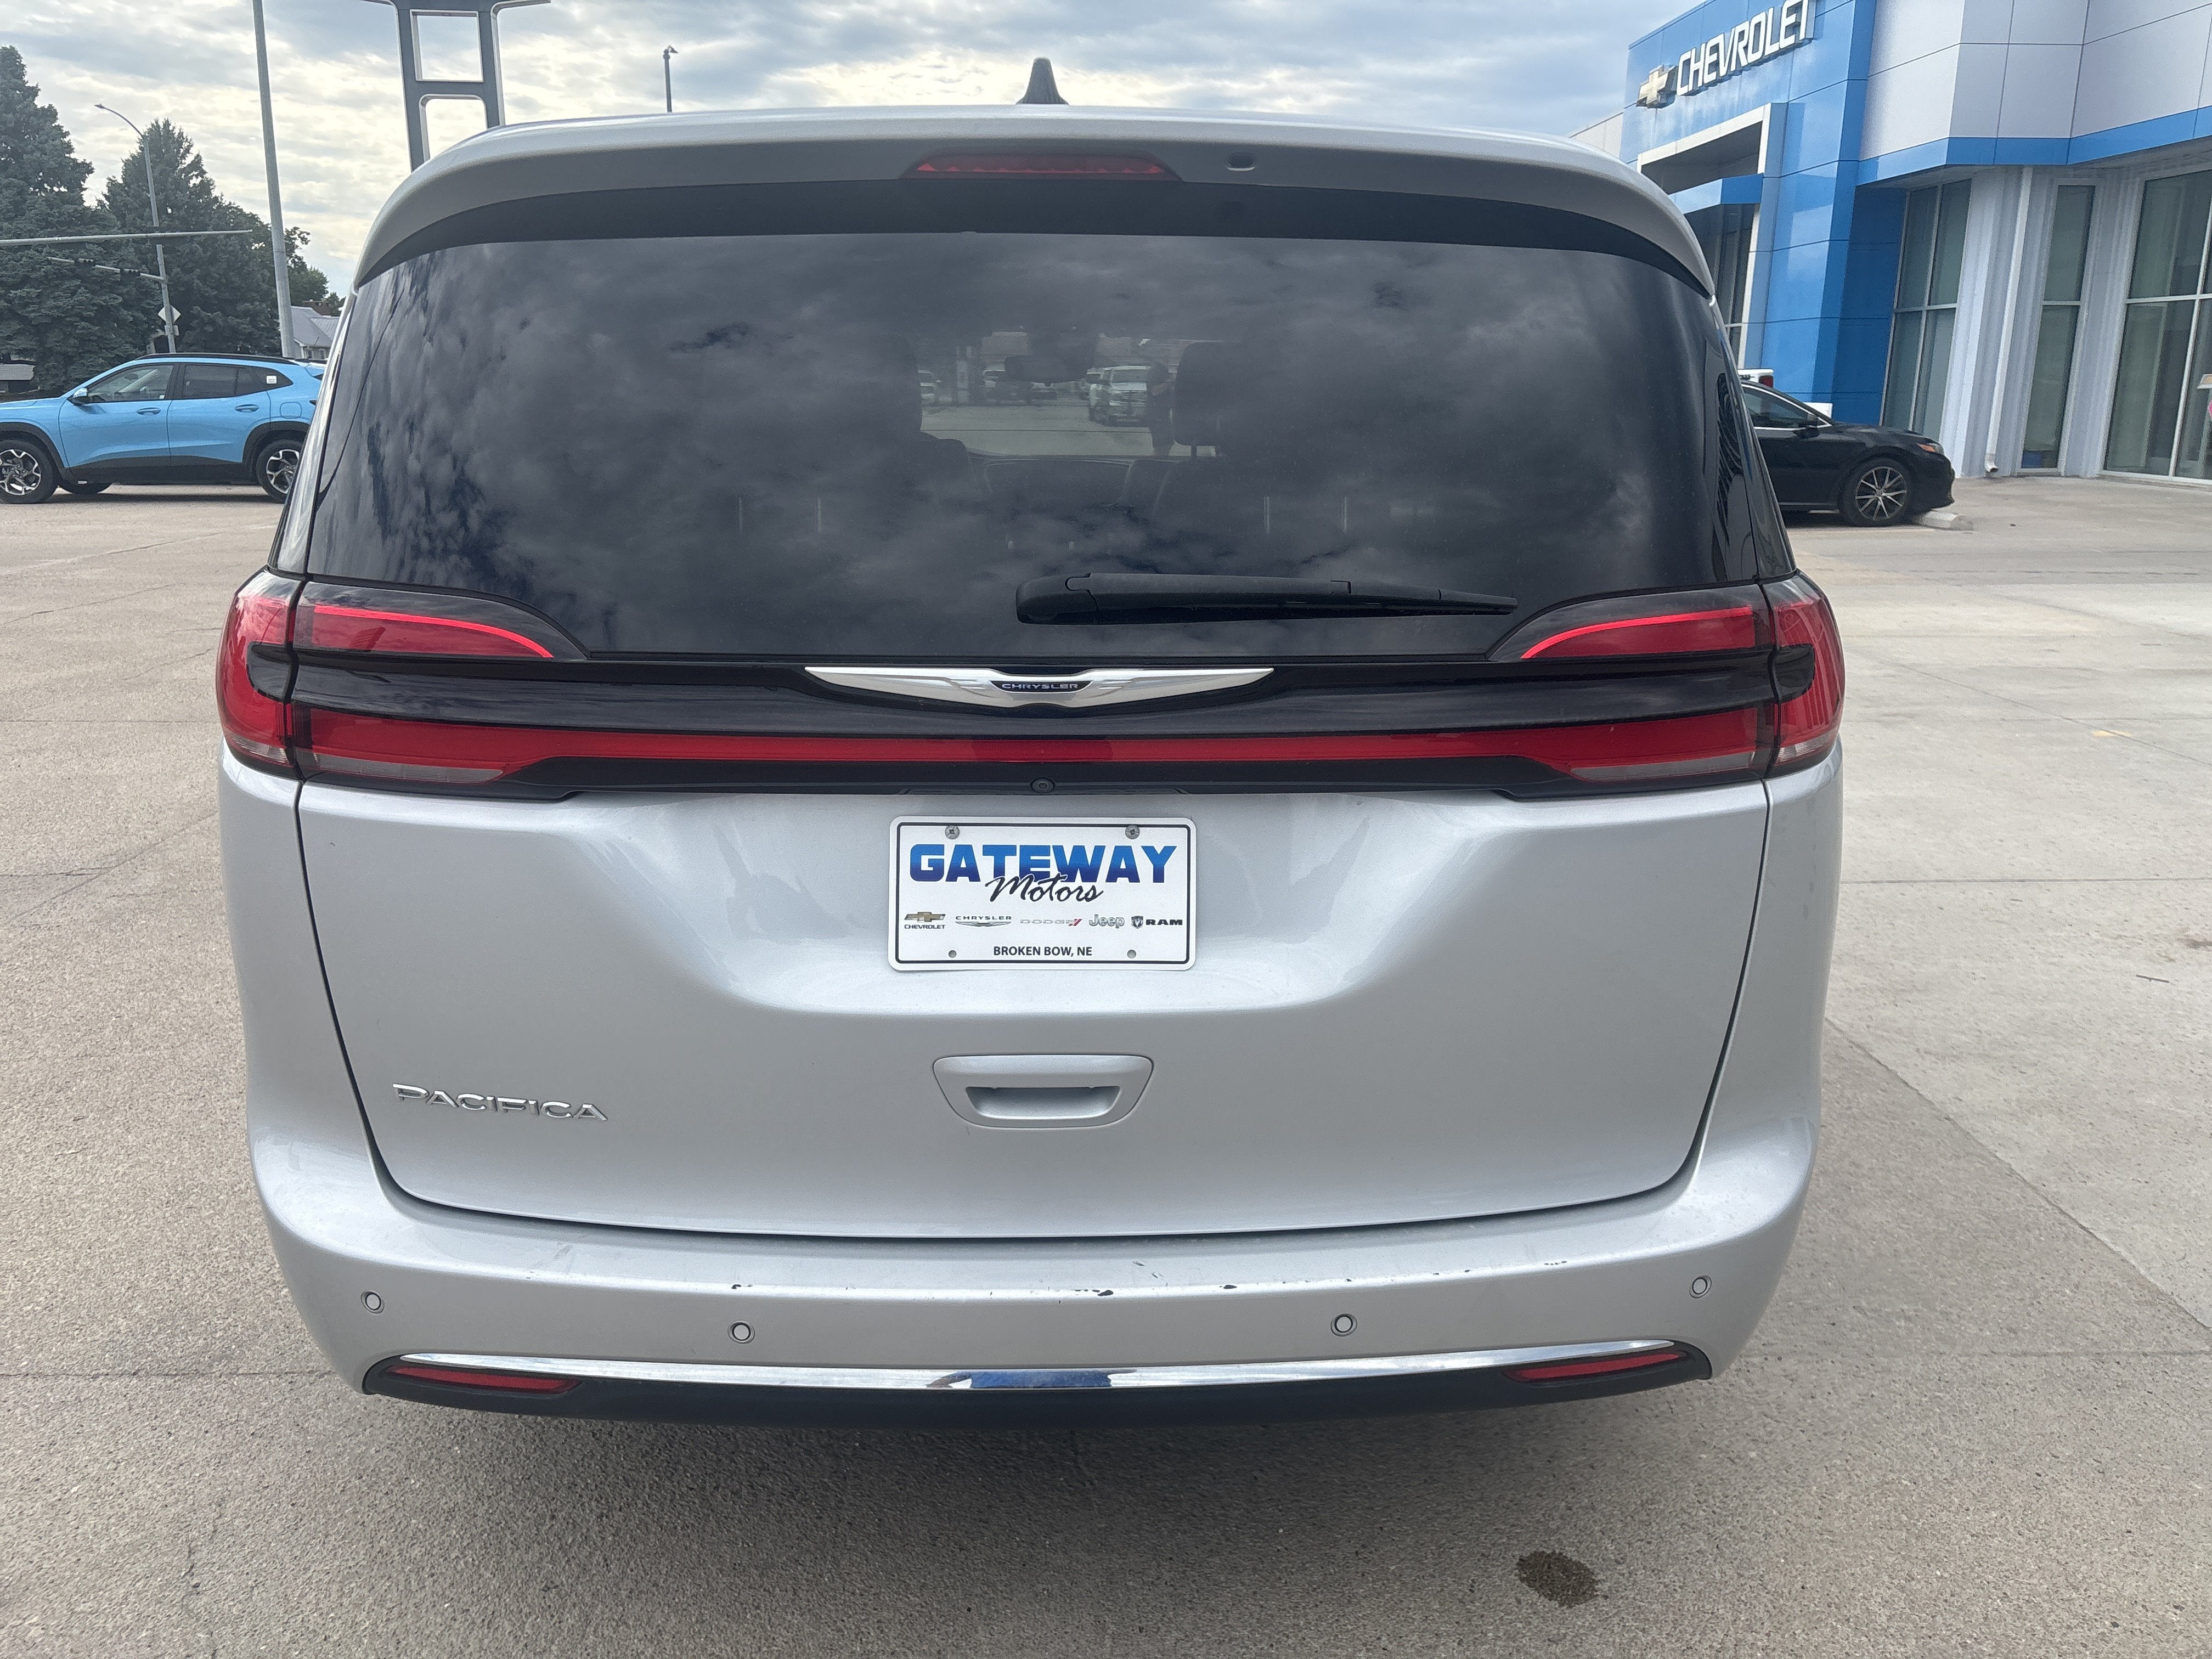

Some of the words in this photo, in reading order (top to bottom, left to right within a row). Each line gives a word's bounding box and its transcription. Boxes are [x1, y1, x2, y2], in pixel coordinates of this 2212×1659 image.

[1677, 0, 1810, 96] CHEVROLET
[910, 844, 1177, 883] GATEWAY
[985, 873, 1104, 902] Motors
[1088, 914, 1125, 929] Jeep
[994, 946, 1041, 956] BROKEN
[1043, 946, 1074, 958] BOW,
[1077, 946, 1092, 956] NE
[392, 1083, 608, 1121] PACIFICA
